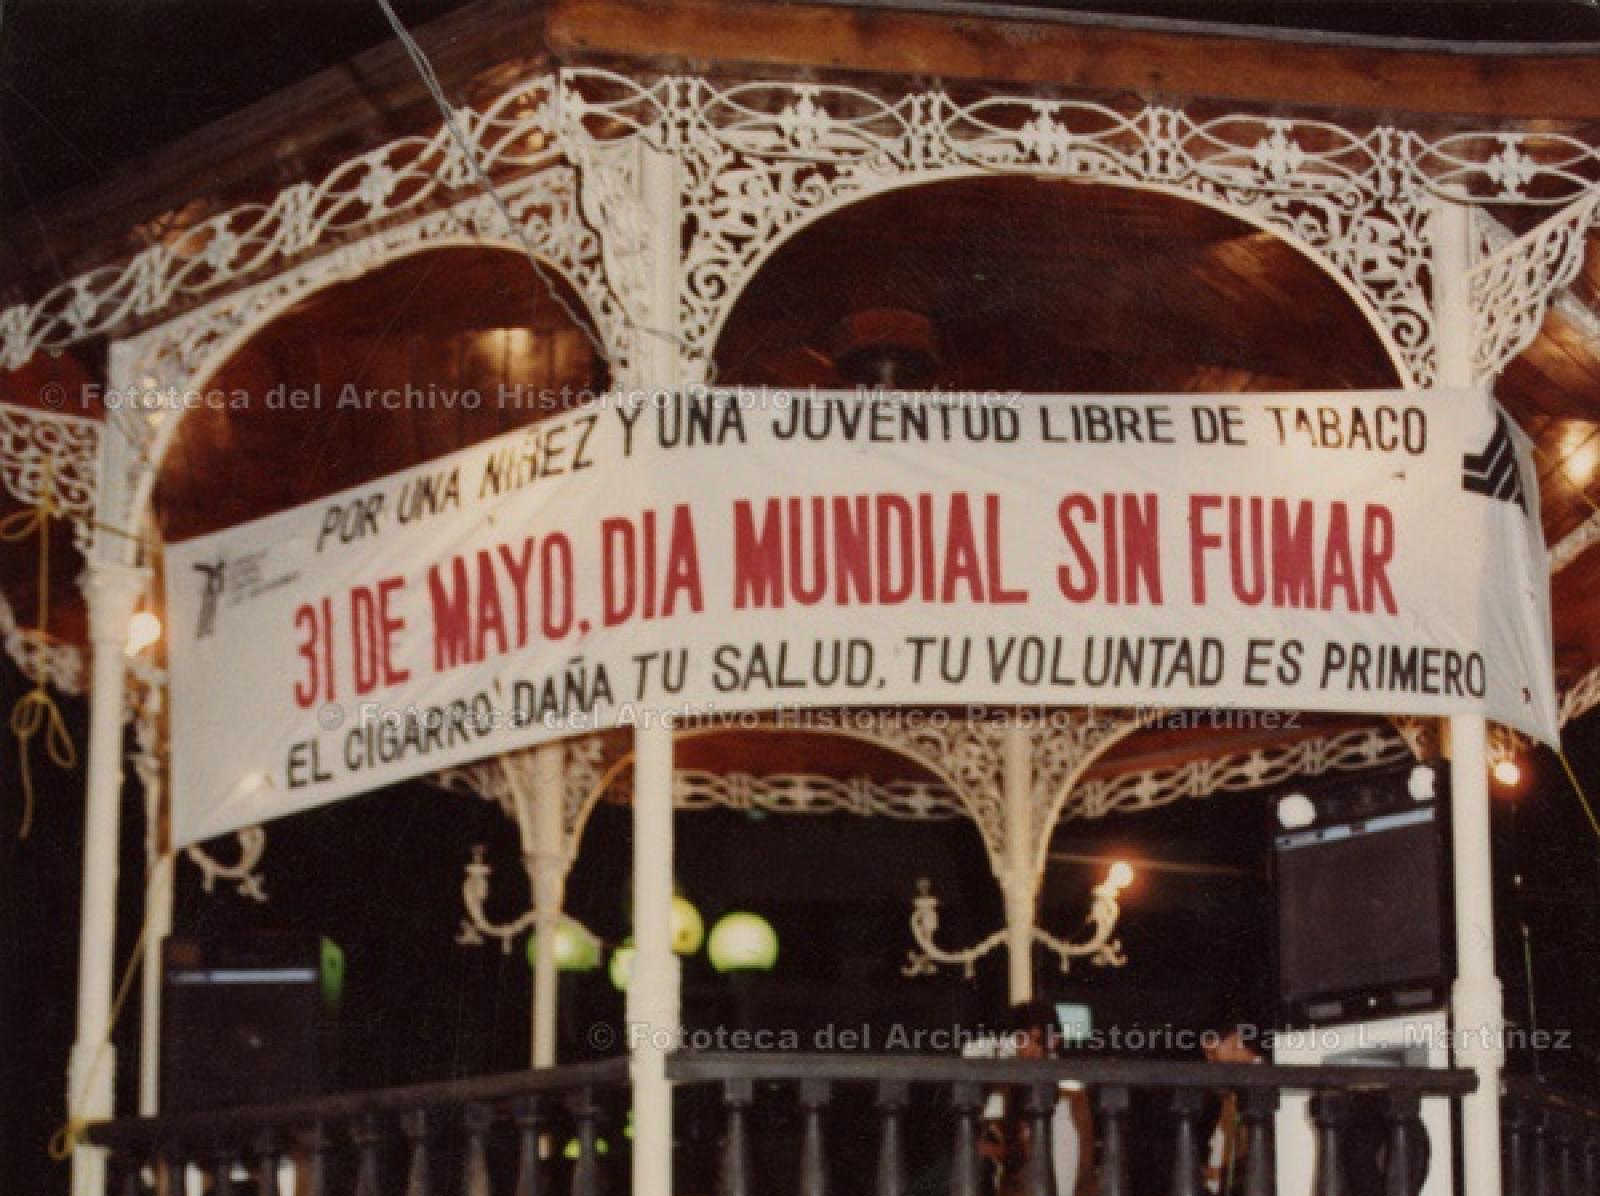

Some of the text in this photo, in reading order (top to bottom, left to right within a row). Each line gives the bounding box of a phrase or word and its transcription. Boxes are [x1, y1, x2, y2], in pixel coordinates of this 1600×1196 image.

[315, 390, 1428, 552] POR UNA NIÑEZ Y UNA JUVENTUD LIBRE DE TABACO
[293, 597, 336, 710] 31
[350, 575, 411, 696] DE
[601, 502, 705, 628] DIA
[732, 490, 1030, 609] MUNDIAL
[1056, 492, 1165, 606] SIN
[1187, 493, 1399, 617] FUMAR
[286, 736, 332, 790] EL
[512, 656, 614, 727] DAÑA
[632, 647, 689, 700] TU
[711, 638, 887, 694] SALUD,
[906, 636, 971, 683] TU
[986, 635, 1225, 687] VOLUNTAD
[1243, 639, 1305, 686] ES
[1319, 641, 1486, 698] PRIMERO
